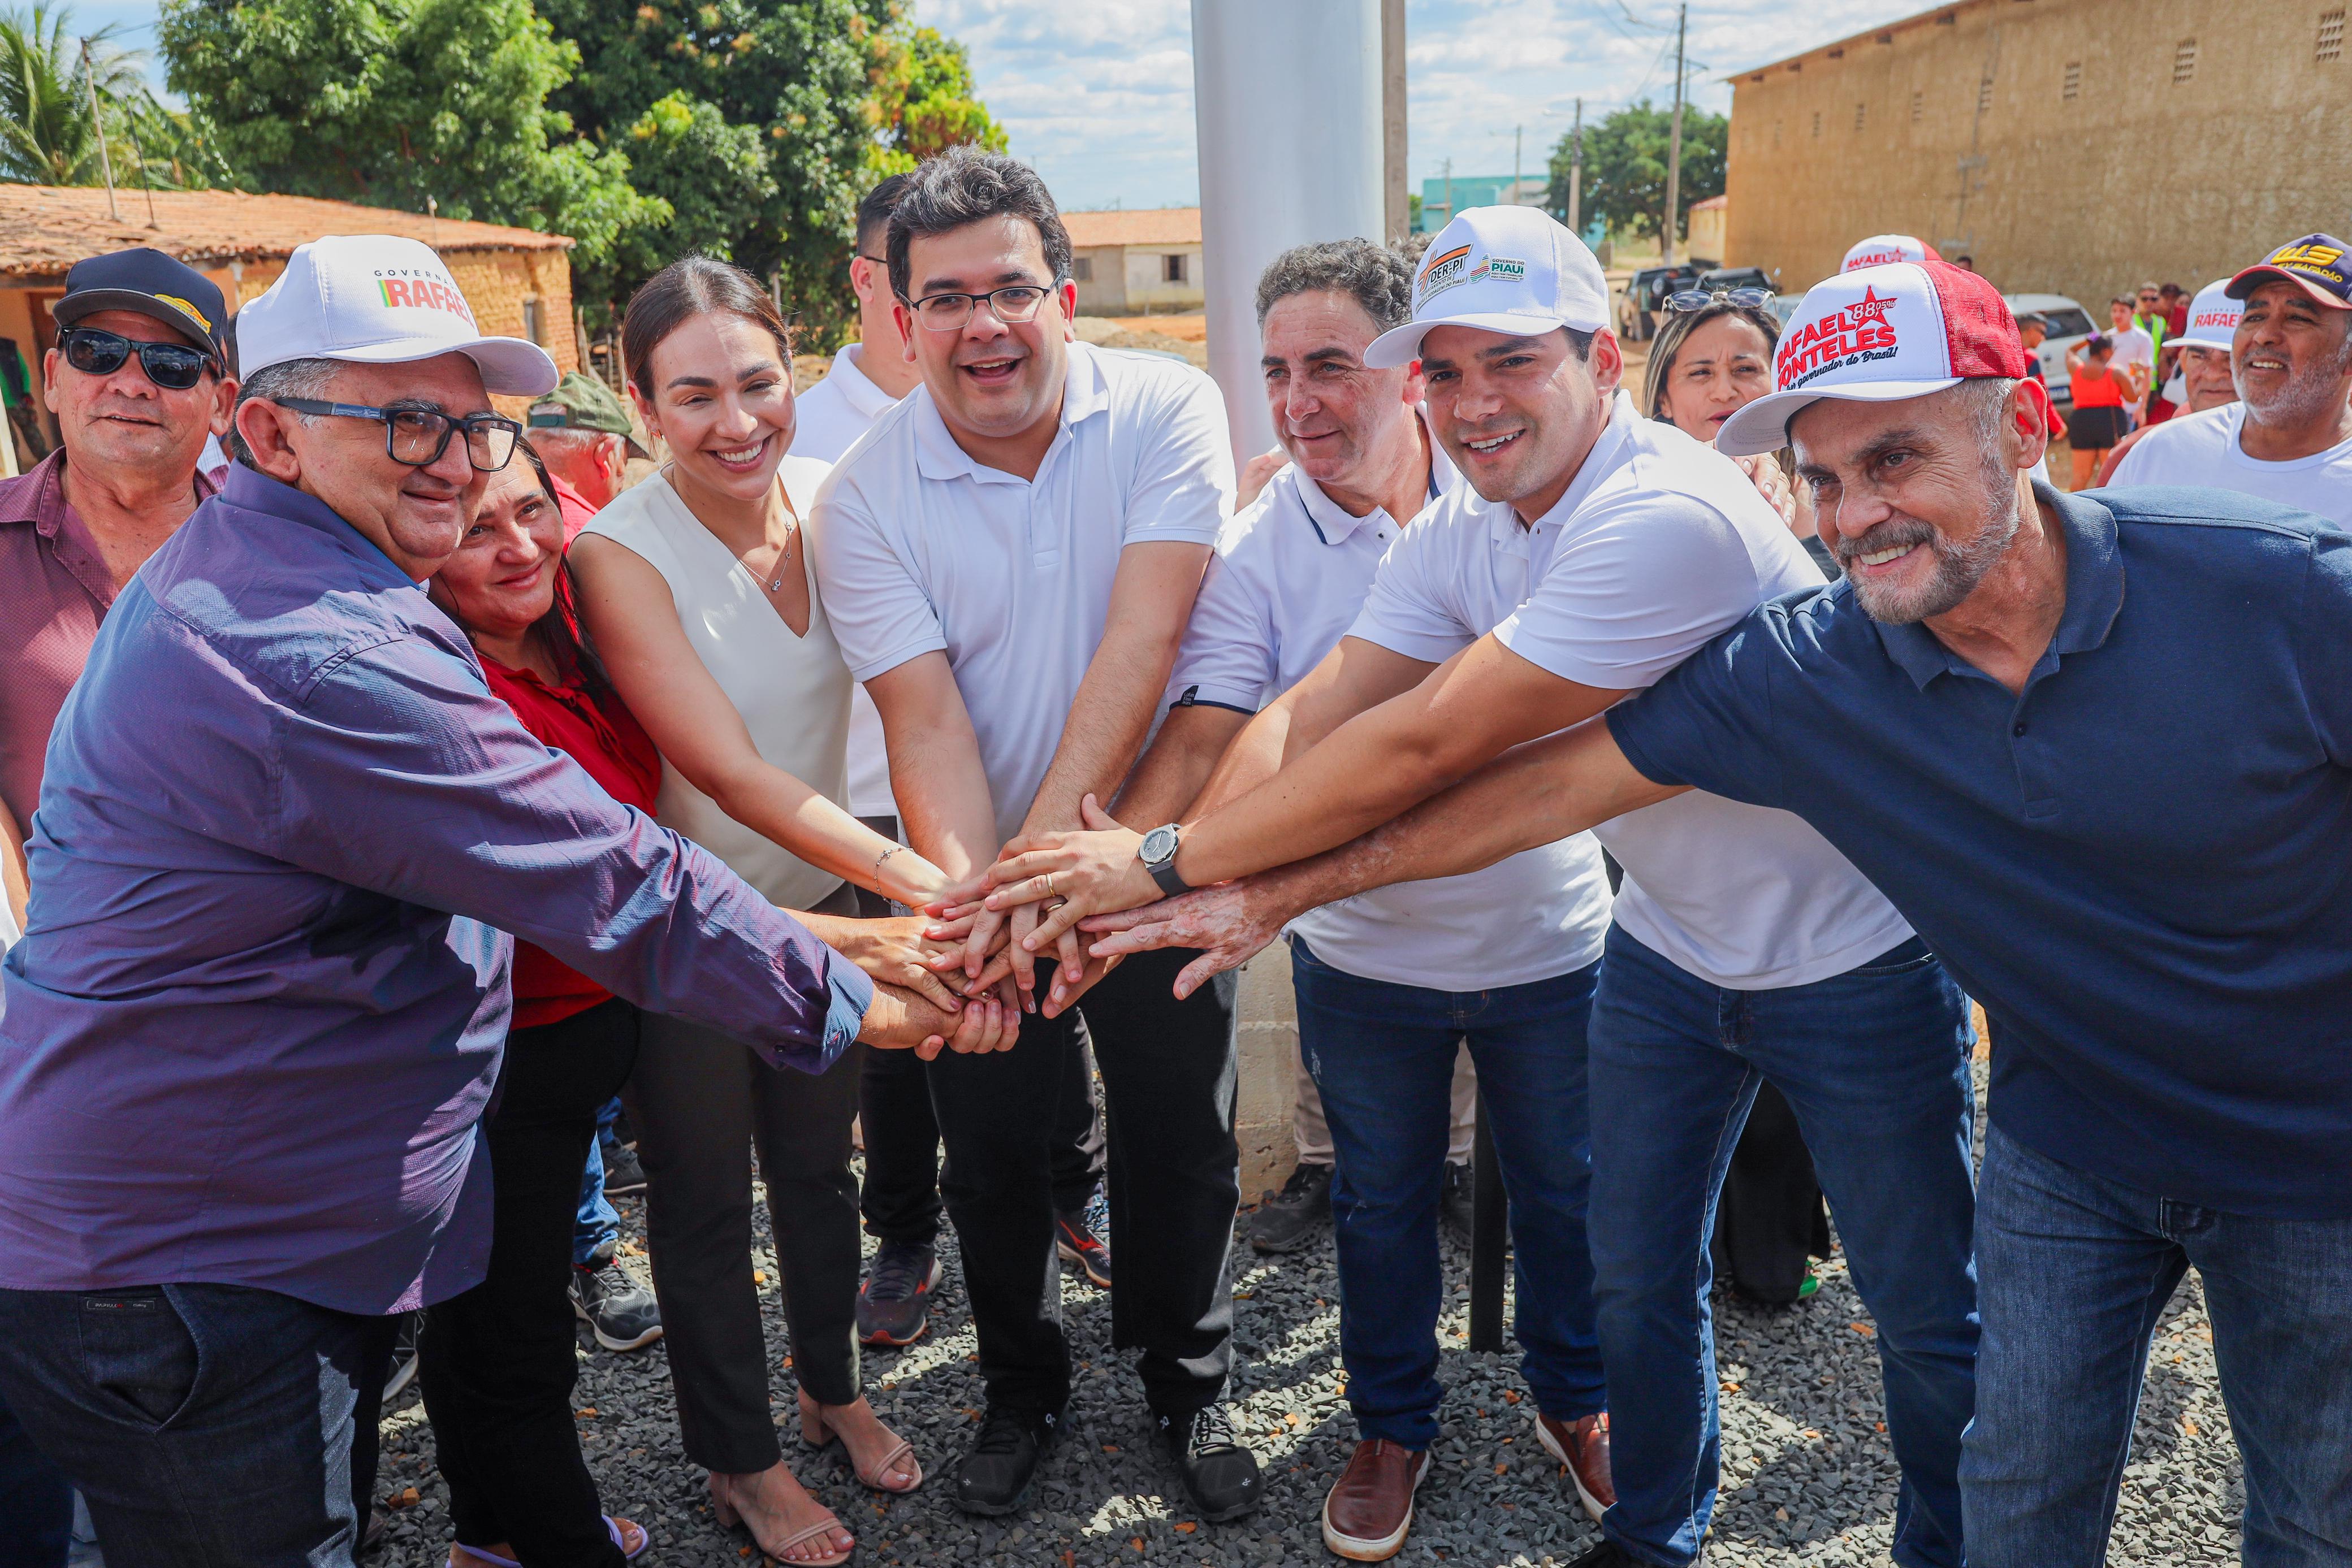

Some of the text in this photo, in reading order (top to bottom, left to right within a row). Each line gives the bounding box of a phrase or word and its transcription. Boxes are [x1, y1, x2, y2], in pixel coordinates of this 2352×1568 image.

[1430, 258, 1463, 283] DER-PI
[1848, 254, 1889, 267] RAFAEL
[1778, 312, 1856, 373] RAFAEL
[1798, 358, 1844, 388] governador
